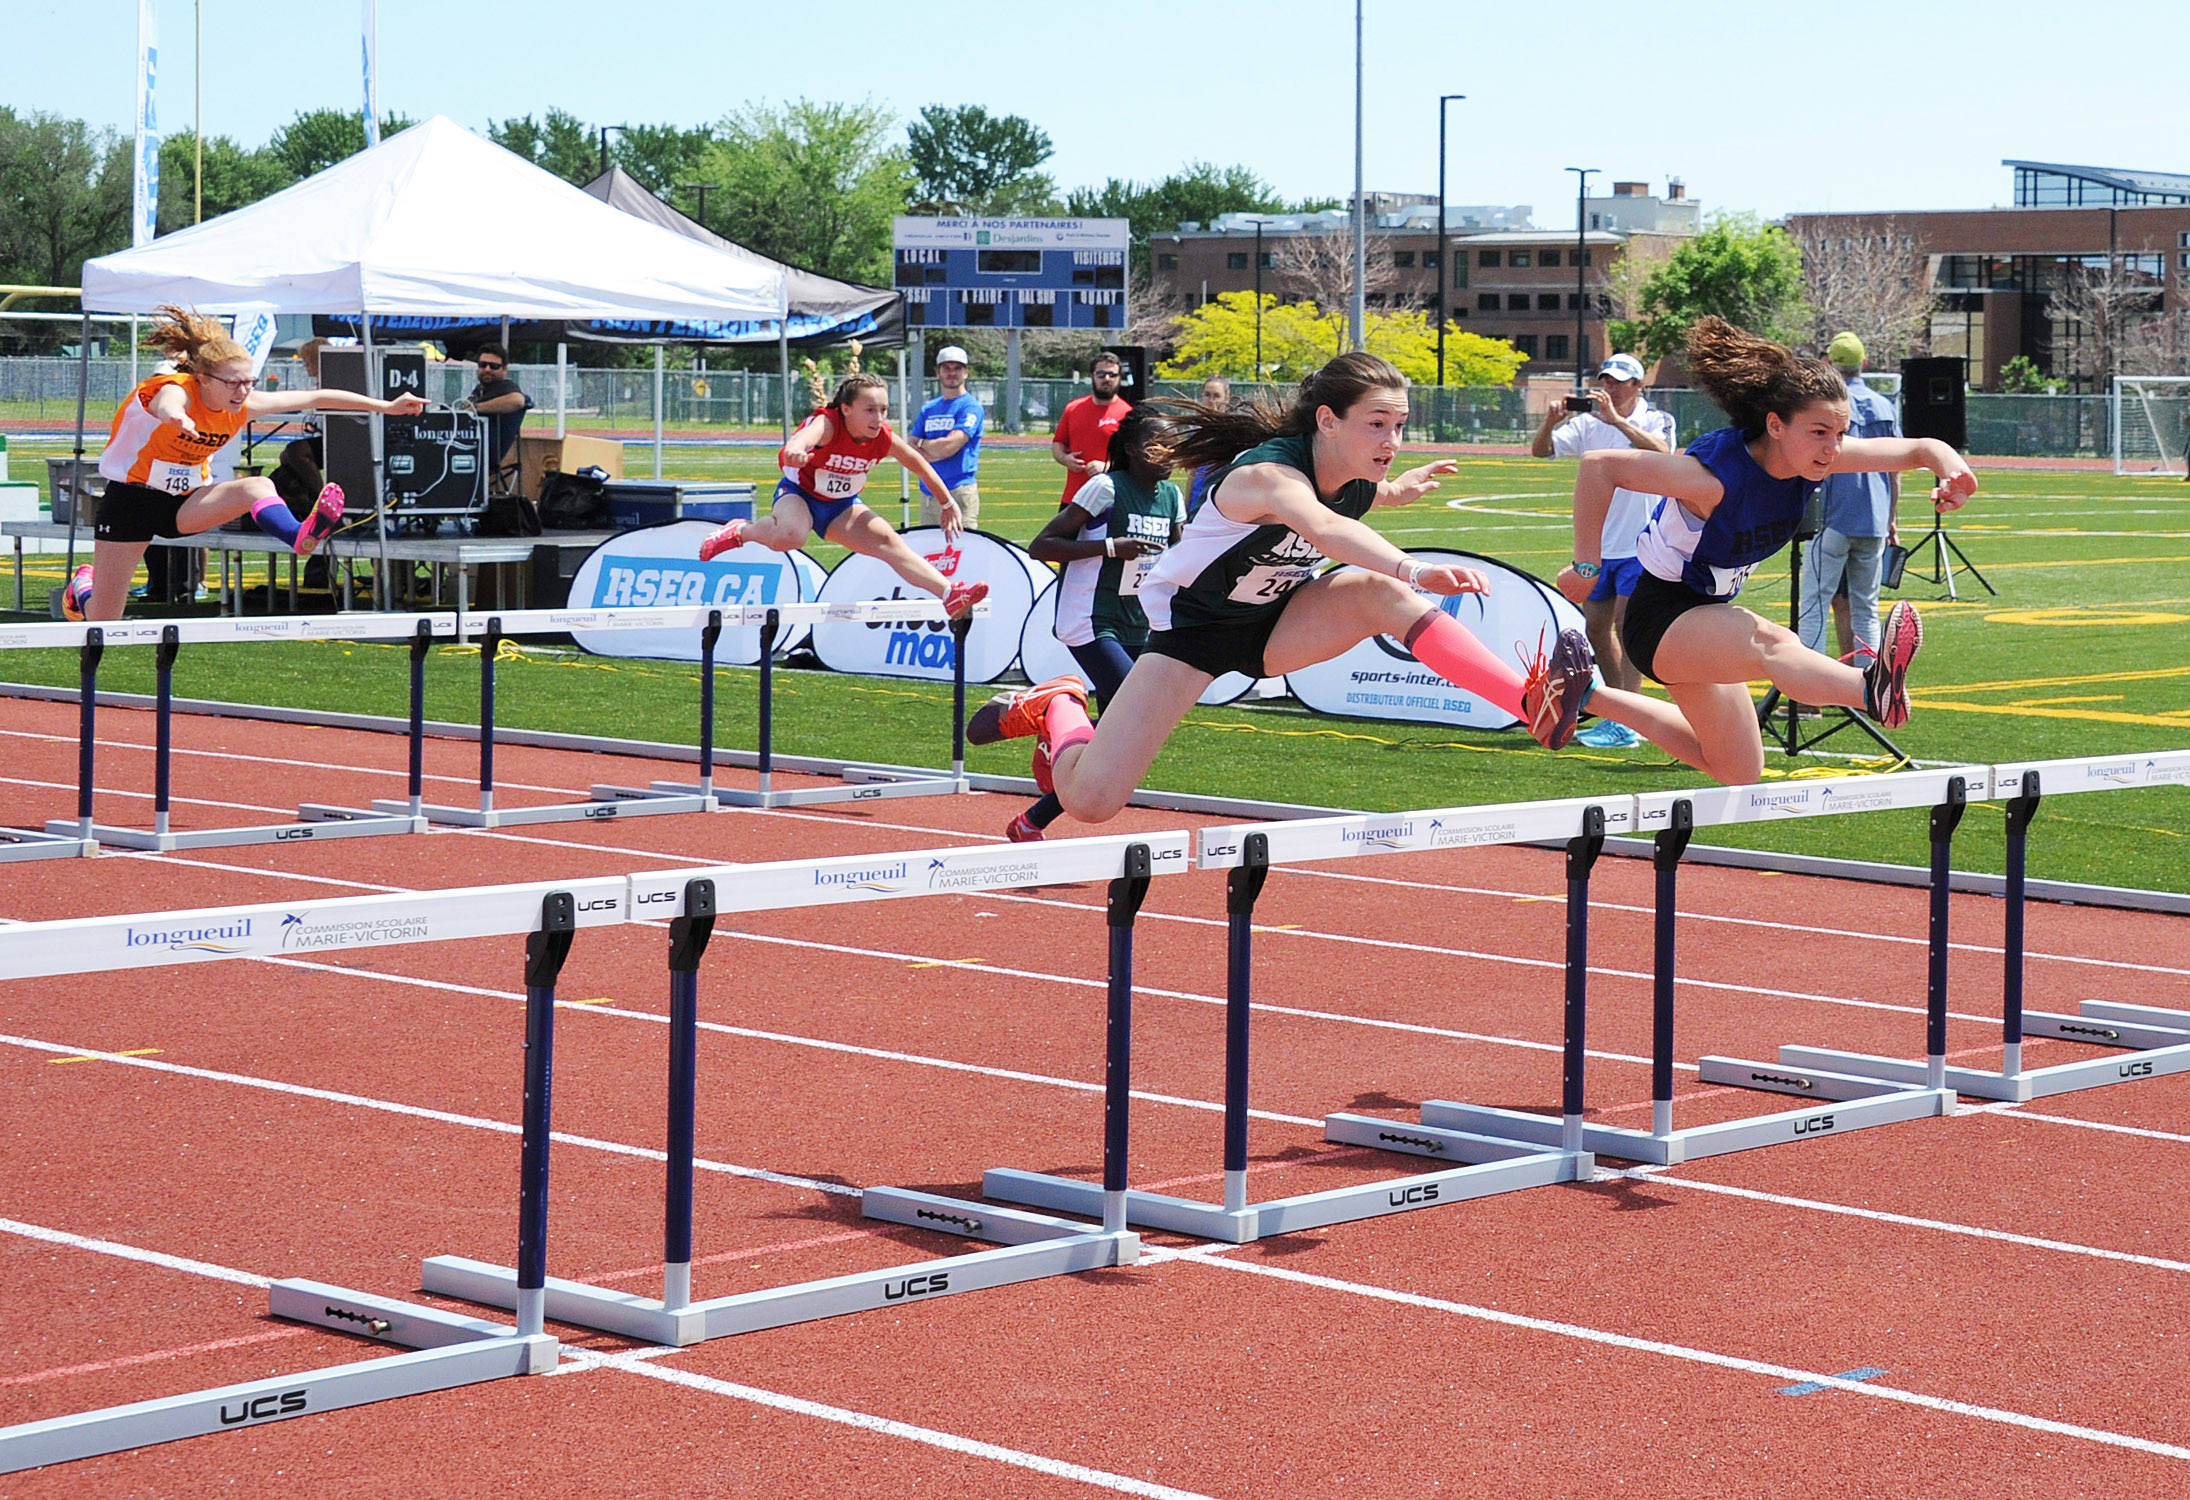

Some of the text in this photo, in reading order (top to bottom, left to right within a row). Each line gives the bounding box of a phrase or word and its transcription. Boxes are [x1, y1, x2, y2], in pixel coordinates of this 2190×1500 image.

[936, 220, 968, 228] MERCI
[983, 220, 1007, 229] NOS
[993, 233, 1044, 244] Desjardins
[904, 250, 940, 263] LOCAL
[1073, 251, 1122, 265] VISITEURS
[1080, 290, 1116, 305] QUART
[389, 369, 419, 388] D-4
[165, 477, 190, 492] 148
[826, 480, 852, 493] 420
[1127, 513, 1171, 537] RSEQ
[602, 567, 765, 606] RSEQ.CA
[1256, 578, 1302, 597] 24
[235, 621, 289, 634] longueuil
[1346, 692, 1472, 713] DISTRIBUTEUR OFFICIEL RSEQ
[2087, 761, 2136, 781] longueuil
[1998, 778, 2018, 787] UCS
[853, 789, 882, 799] UCS
[1750, 789, 1809, 810] longueuil
[1828, 797, 1892, 811] MARIE-VICTORIN
[585, 807, 617, 817] UCS
[1643, 809, 1667, 819] UCS
[276, 828, 314, 840] UCS
[1341, 822, 1414, 847] longueuil
[1438, 823, 1515, 836] COMMISSION SCOLAIRE
[1438, 830, 1516, 846] MARIE-VICTORIN
[1152, 849, 1182, 860] UCS
[1207, 846, 1237, 856] UCS
[814, 862, 907, 889] longueuil
[938, 863, 1038, 877] COMMISSION SCOLAIRE
[938, 871, 1039, 889] MARIE-VICTORIN
[577, 898, 618, 912] UCS
[637, 891, 677, 904] UCS
[295, 916, 428, 935] COMMISSION SCOLAIRE
[126, 918, 253, 950] longueuil
[295, 925, 428, 948] MARIE-VICTORIN
[2119, 1062, 2153, 1077] UCS
[1794, 1114, 1835, 1135] UCS
[1389, 1183, 1439, 1207] UCS
[885, 1272, 949, 1301] UCS
[220, 1389, 309, 1425] UCS
